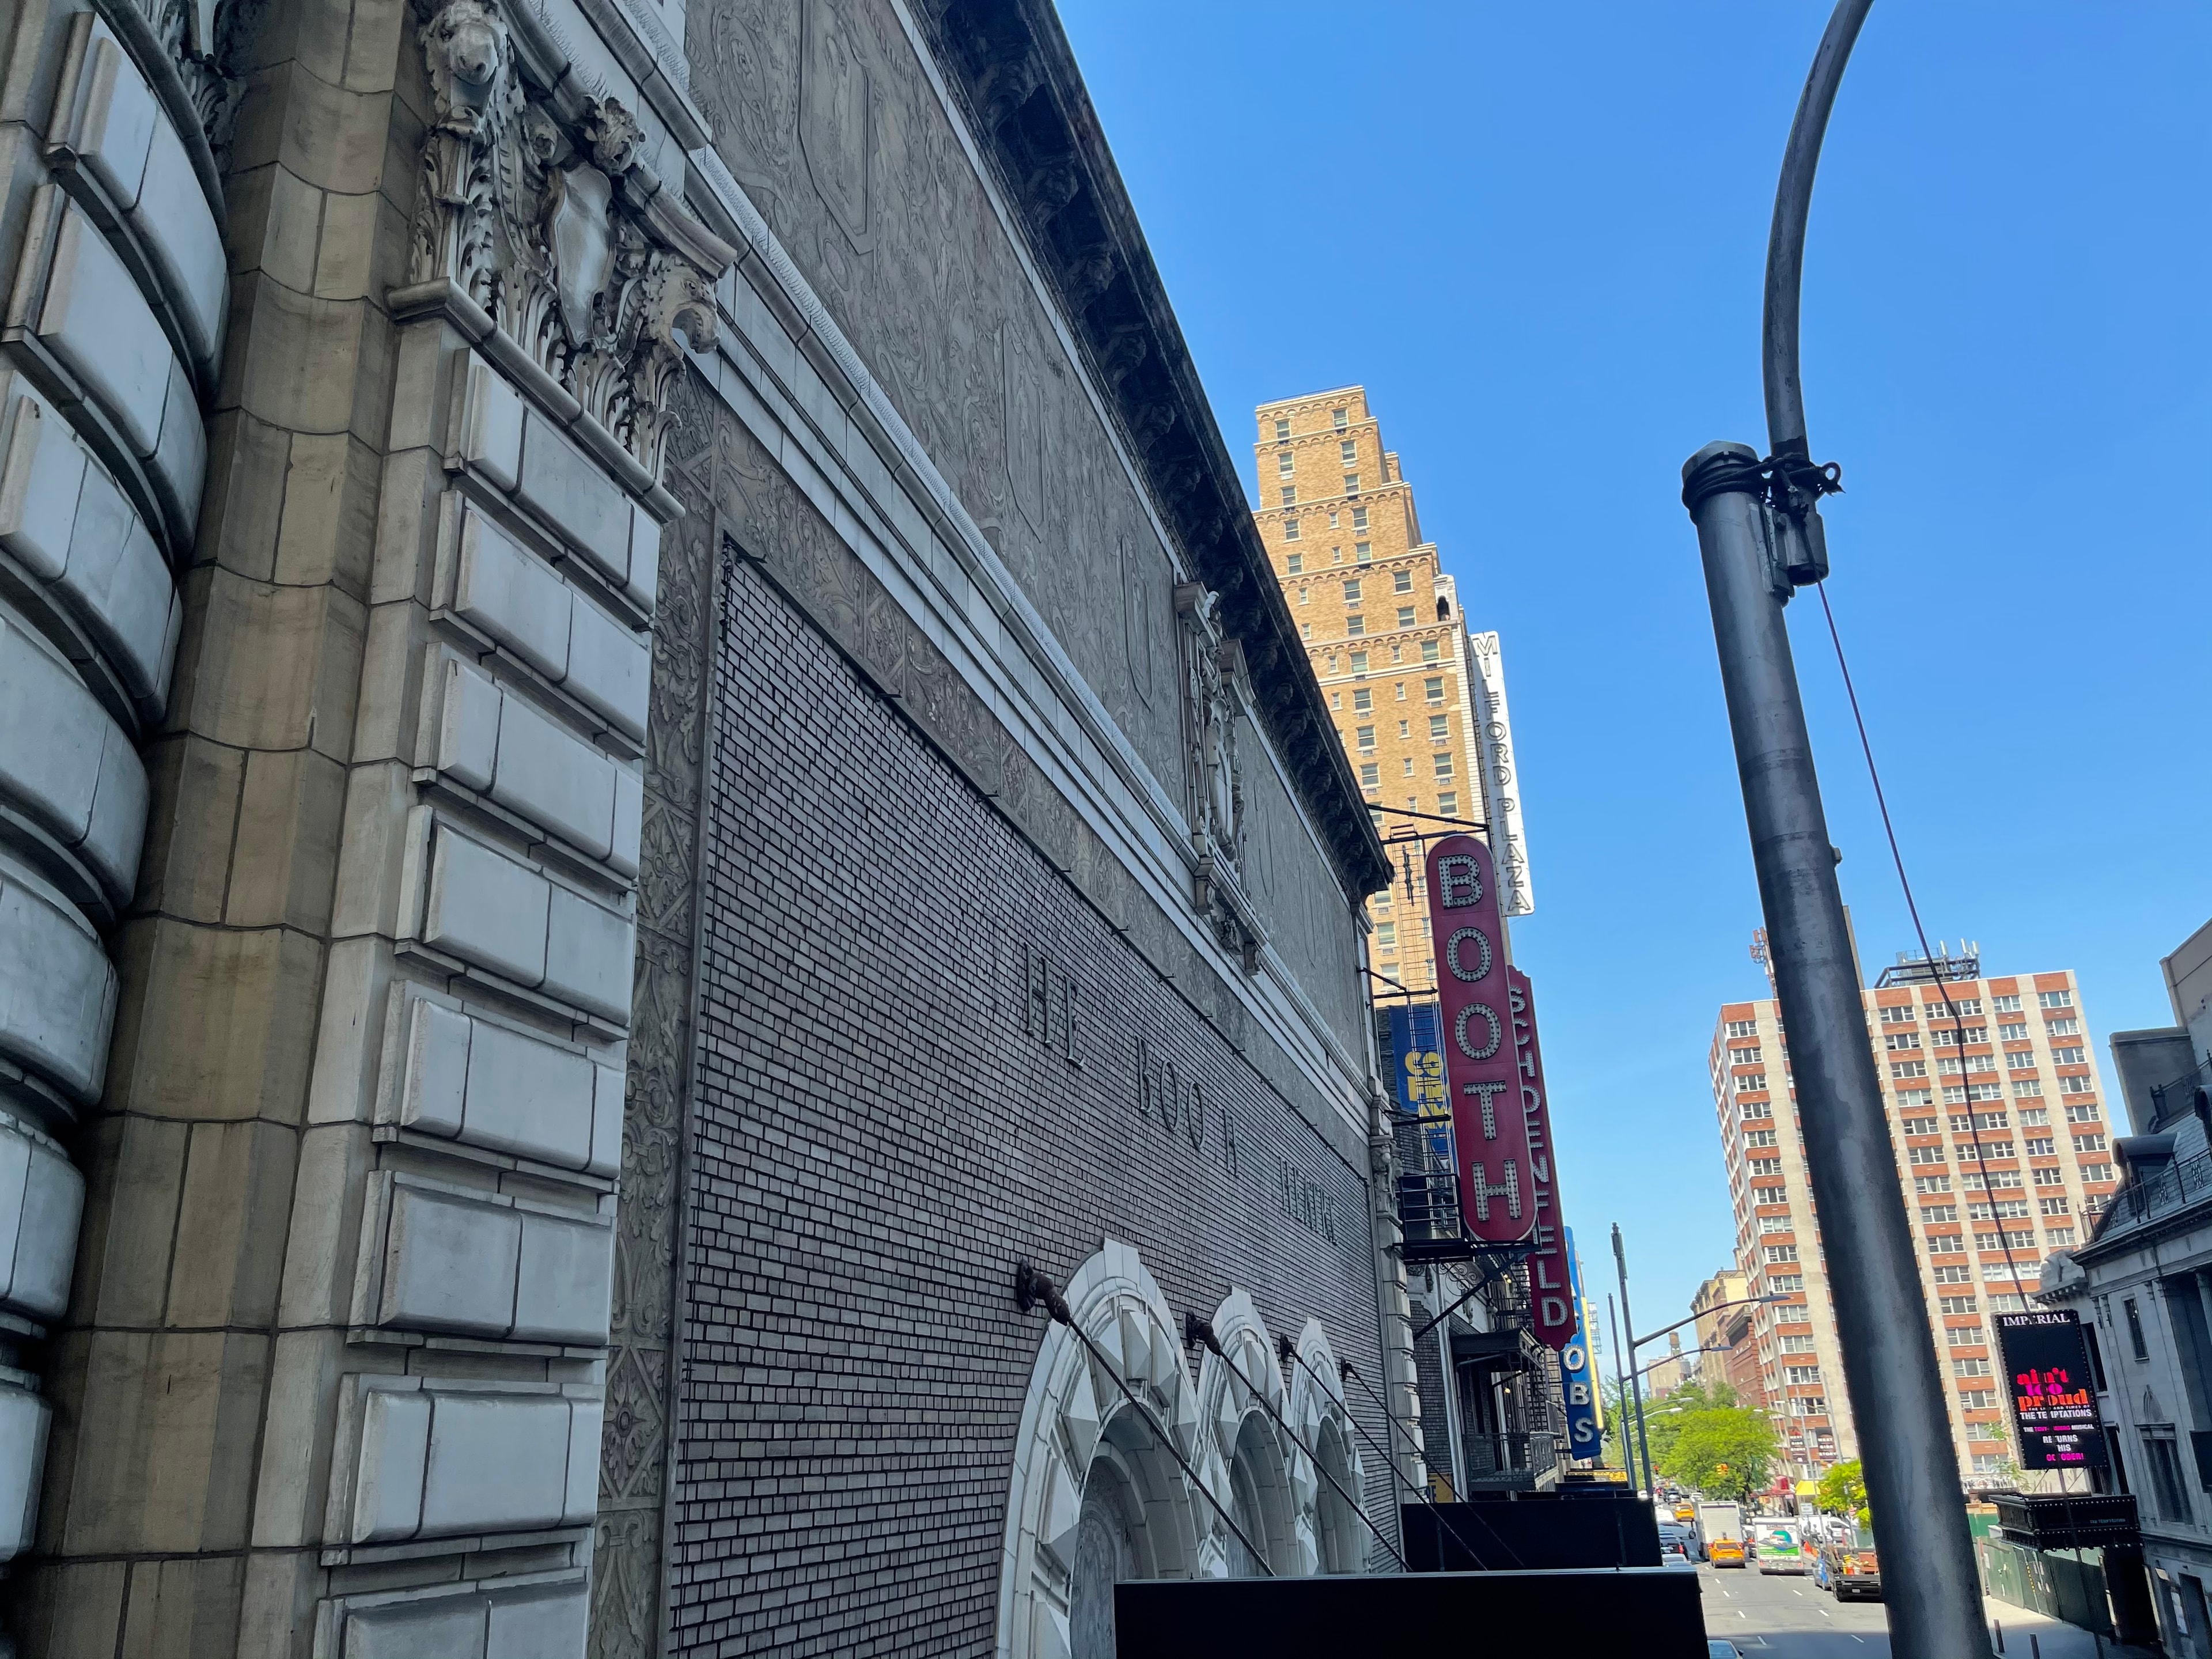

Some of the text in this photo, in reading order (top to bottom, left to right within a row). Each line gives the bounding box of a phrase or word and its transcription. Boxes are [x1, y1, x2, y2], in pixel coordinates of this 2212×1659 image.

[1473, 635, 1531, 912] MILFORD PLAZA
[1437, 854, 1522, 1221] BOOTH
[2017, 1389, 2089, 1412] proud
[2020, 1412, 2036, 1420] THE
[2046, 1453, 2085, 1461] OCOBER!
